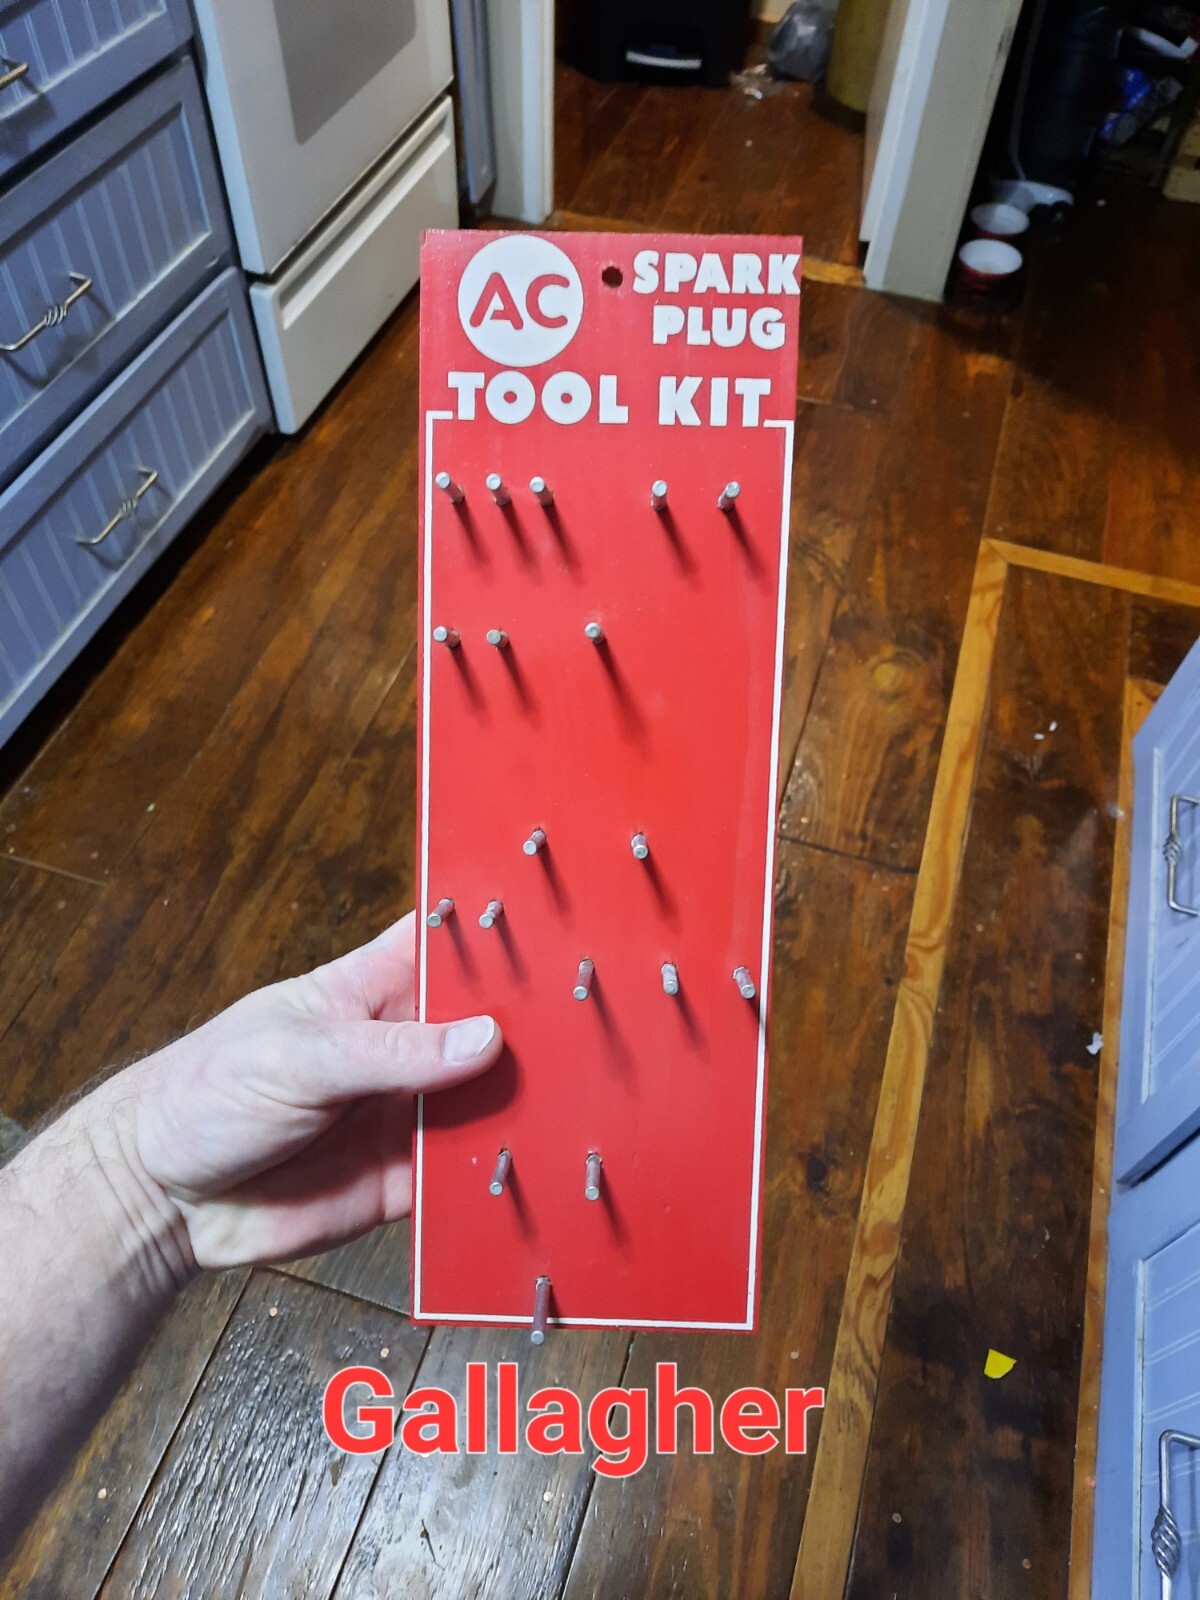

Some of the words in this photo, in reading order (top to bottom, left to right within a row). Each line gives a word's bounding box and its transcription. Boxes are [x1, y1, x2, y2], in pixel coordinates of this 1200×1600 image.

[633, 250, 800, 294] SPARK
[469, 272, 570, 330] AC
[652, 304, 786, 350] PLUG
[447, 370, 629, 425] TOOL
[658, 375, 772, 427] KIT
